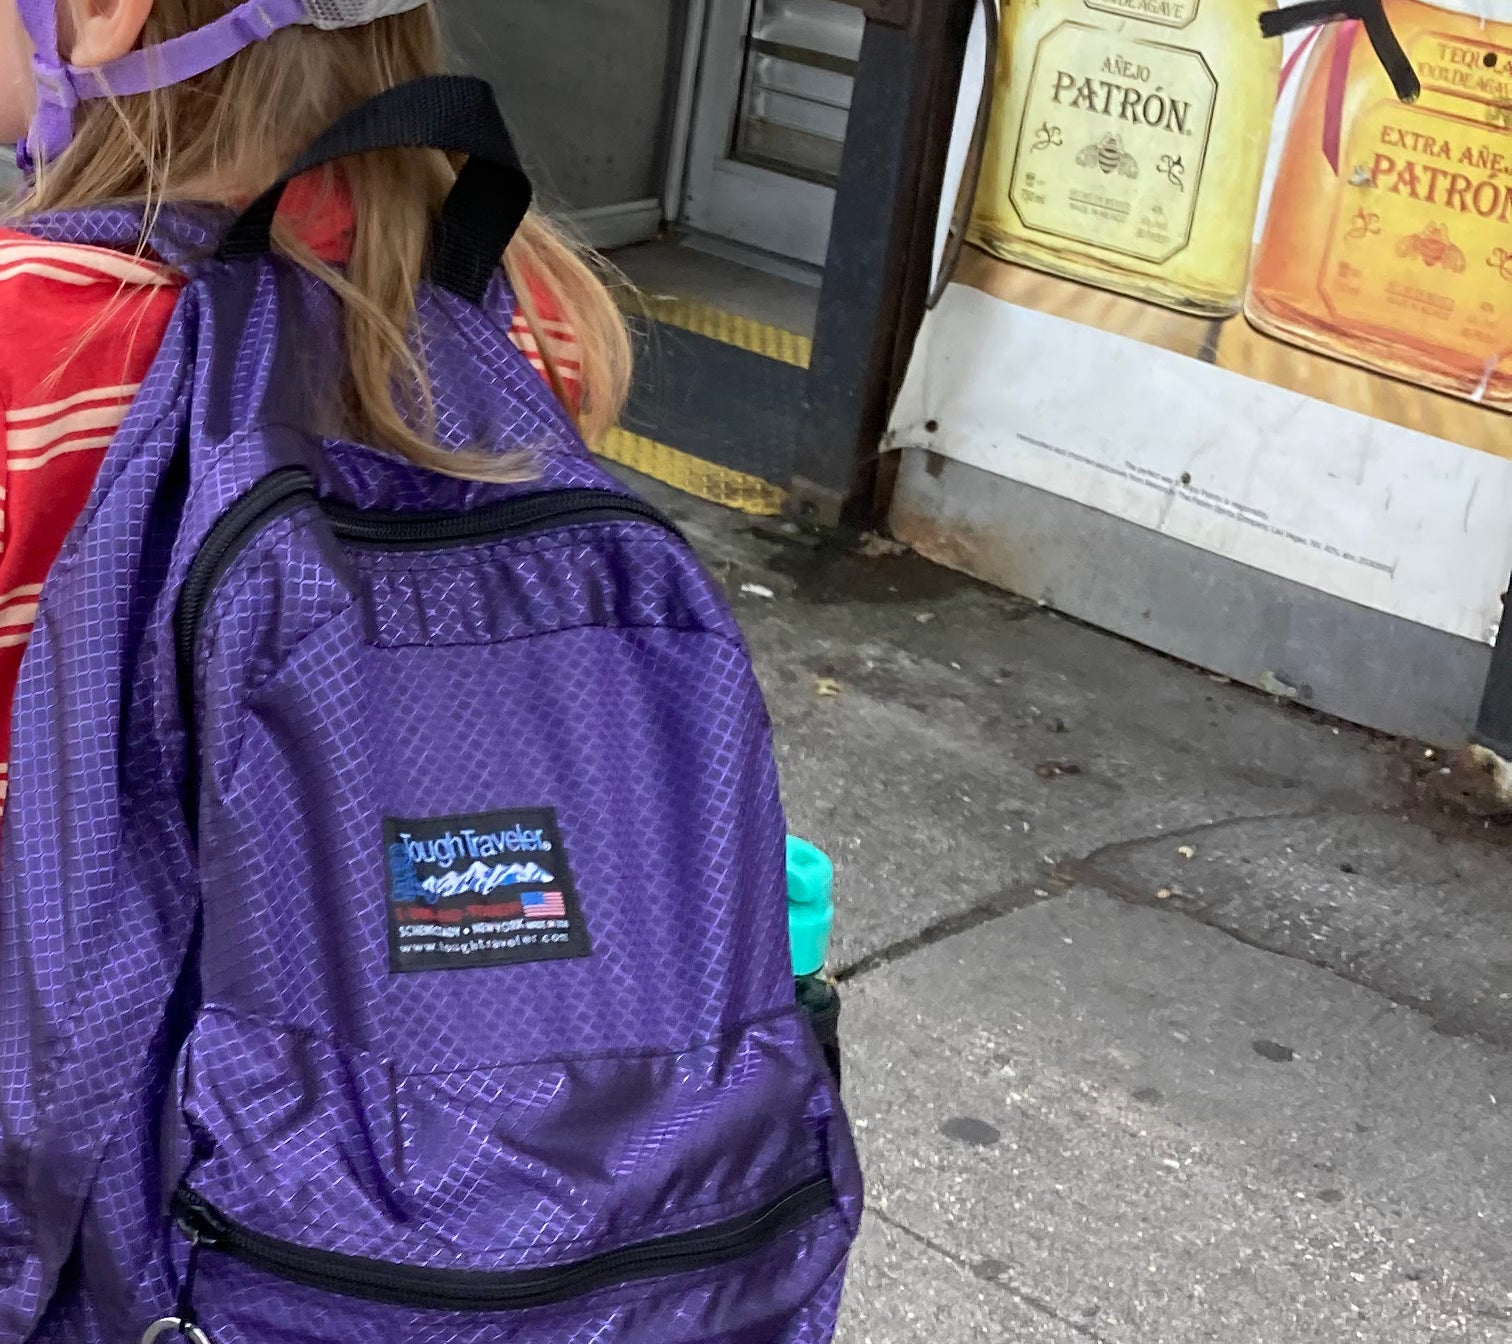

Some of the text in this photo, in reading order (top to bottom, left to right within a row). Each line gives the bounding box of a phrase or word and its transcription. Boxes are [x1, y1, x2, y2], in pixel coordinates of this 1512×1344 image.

[1101, 54, 1151, 82] AÑEJO
[1052, 70, 1192, 134] PATRÓN
[1381, 125, 1452, 160] EXTRA
